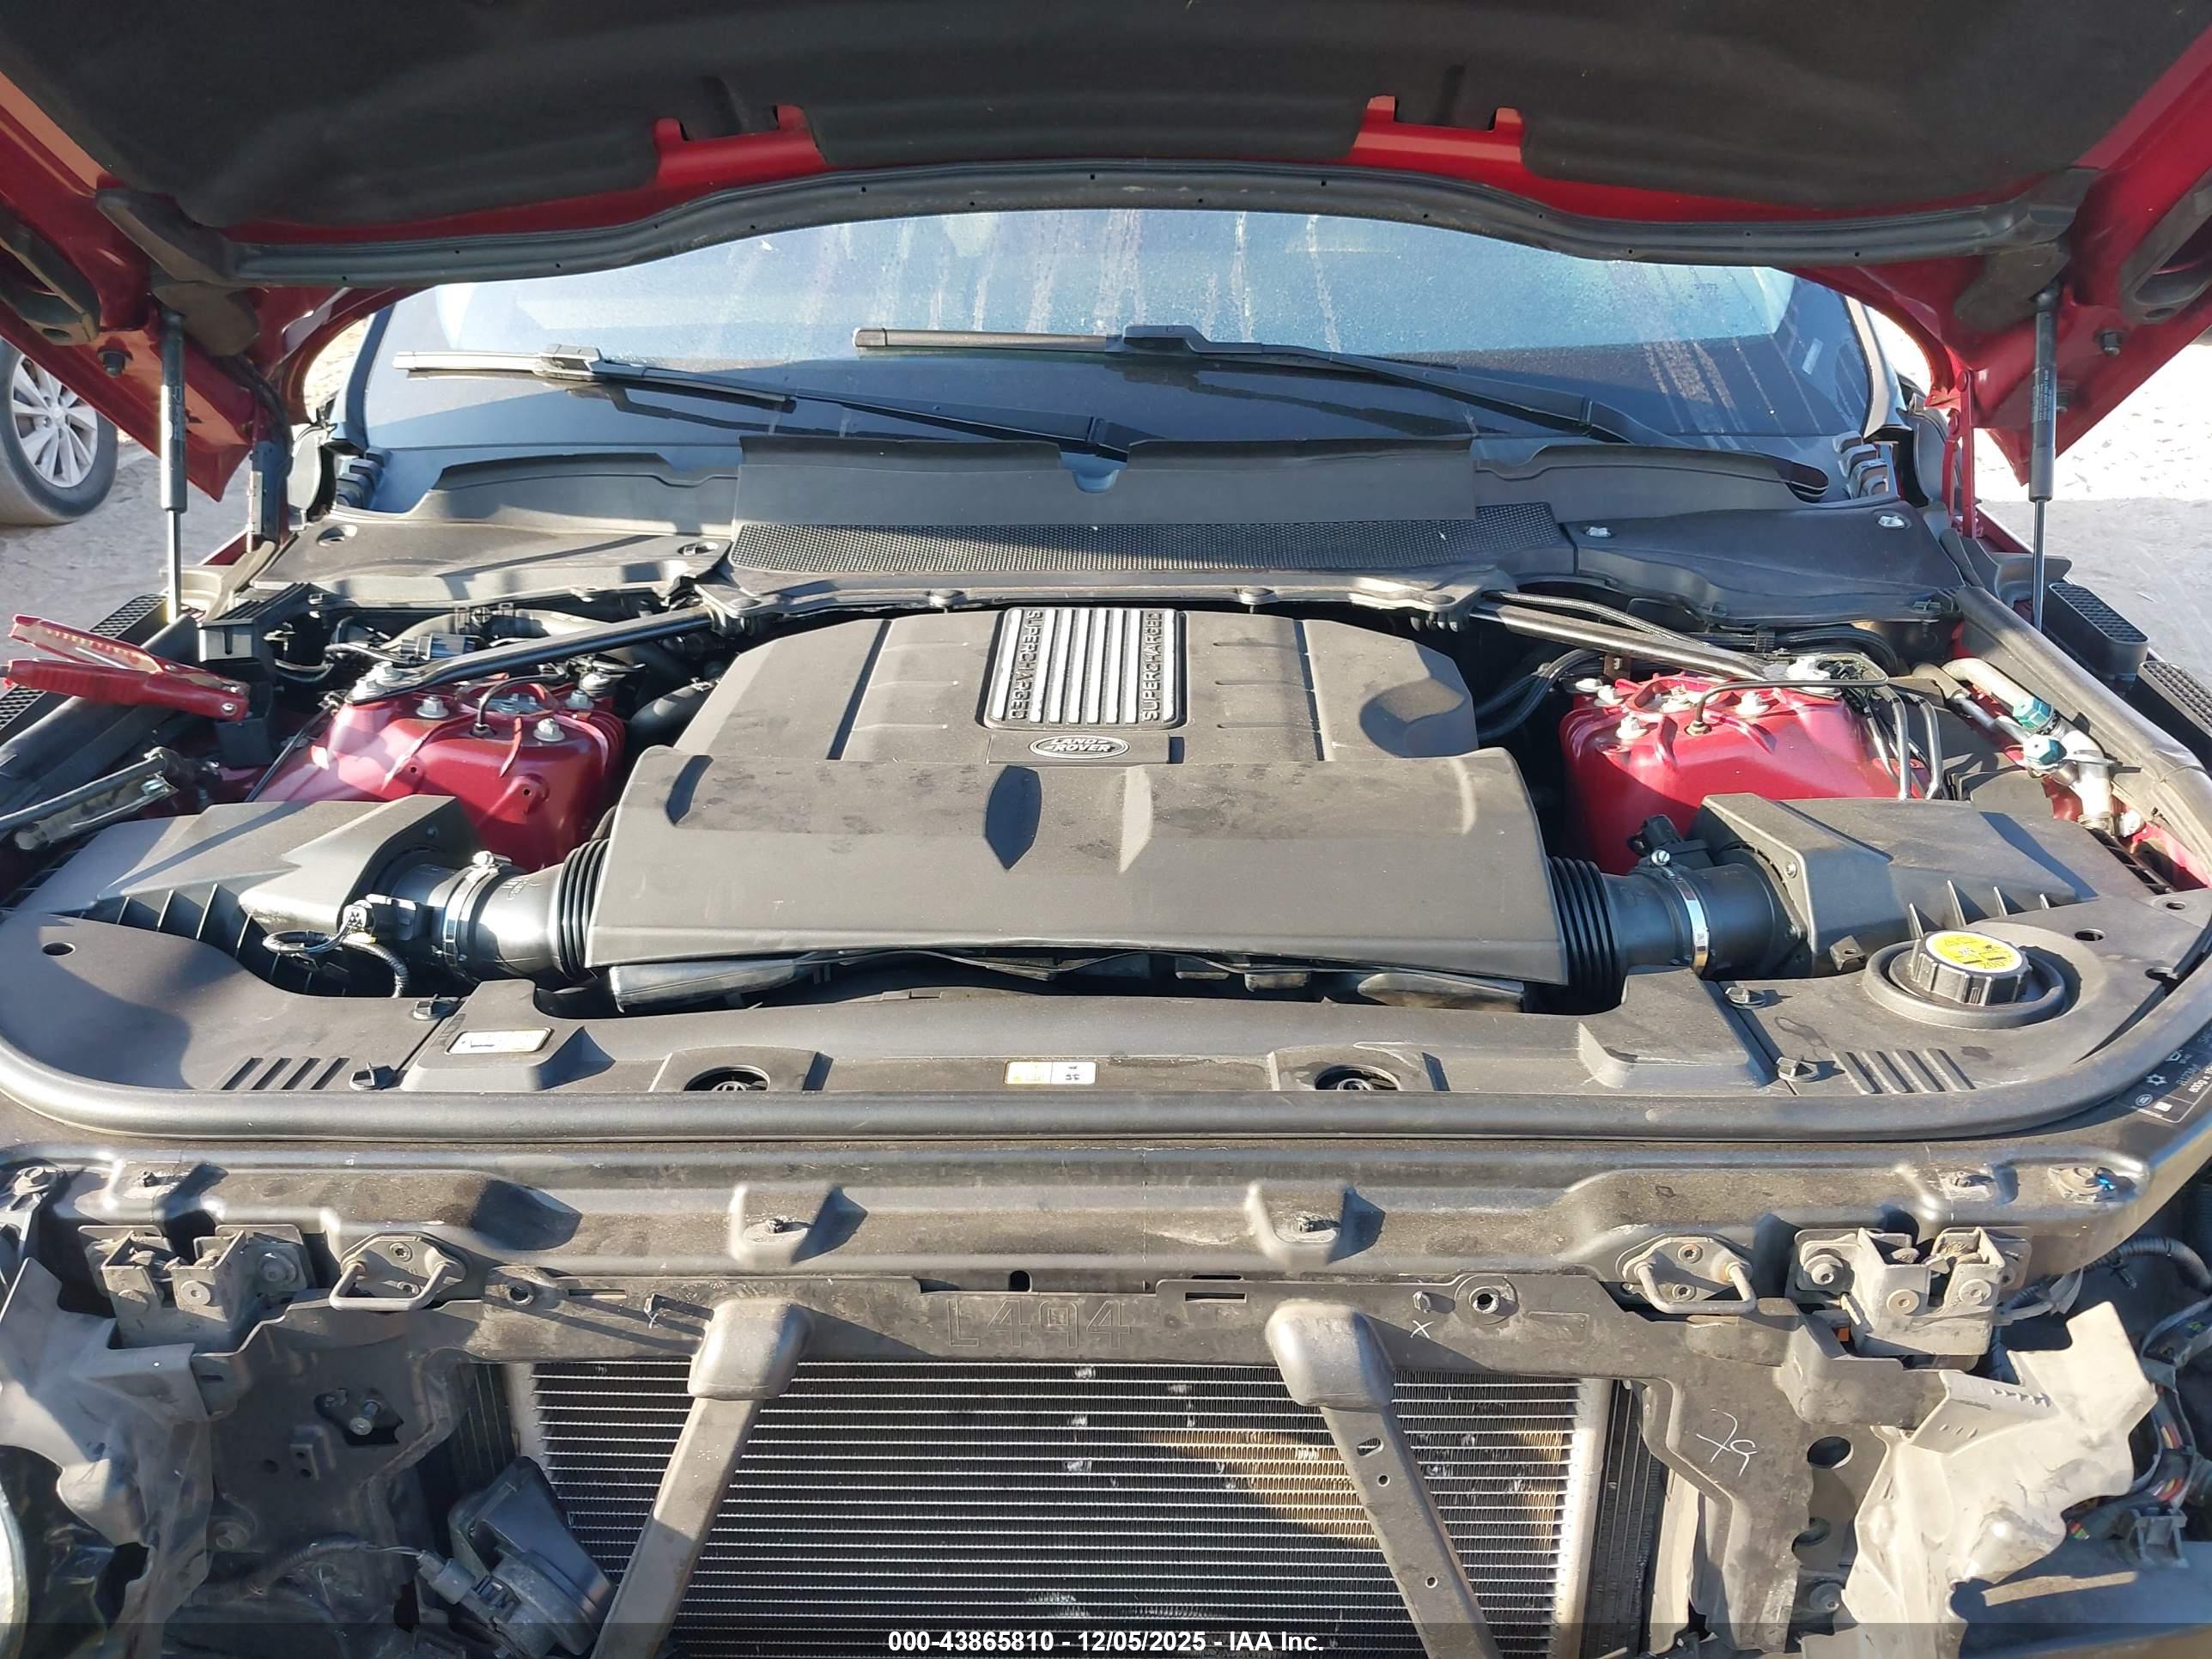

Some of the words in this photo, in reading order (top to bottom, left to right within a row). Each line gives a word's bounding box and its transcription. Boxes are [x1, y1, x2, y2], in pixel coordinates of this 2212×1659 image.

[1008, 610, 1044, 720] SUPERCHARGED
[1141, 612, 1164, 722] SUPERCHARGED
[1053, 744, 1111, 752] ROVER
